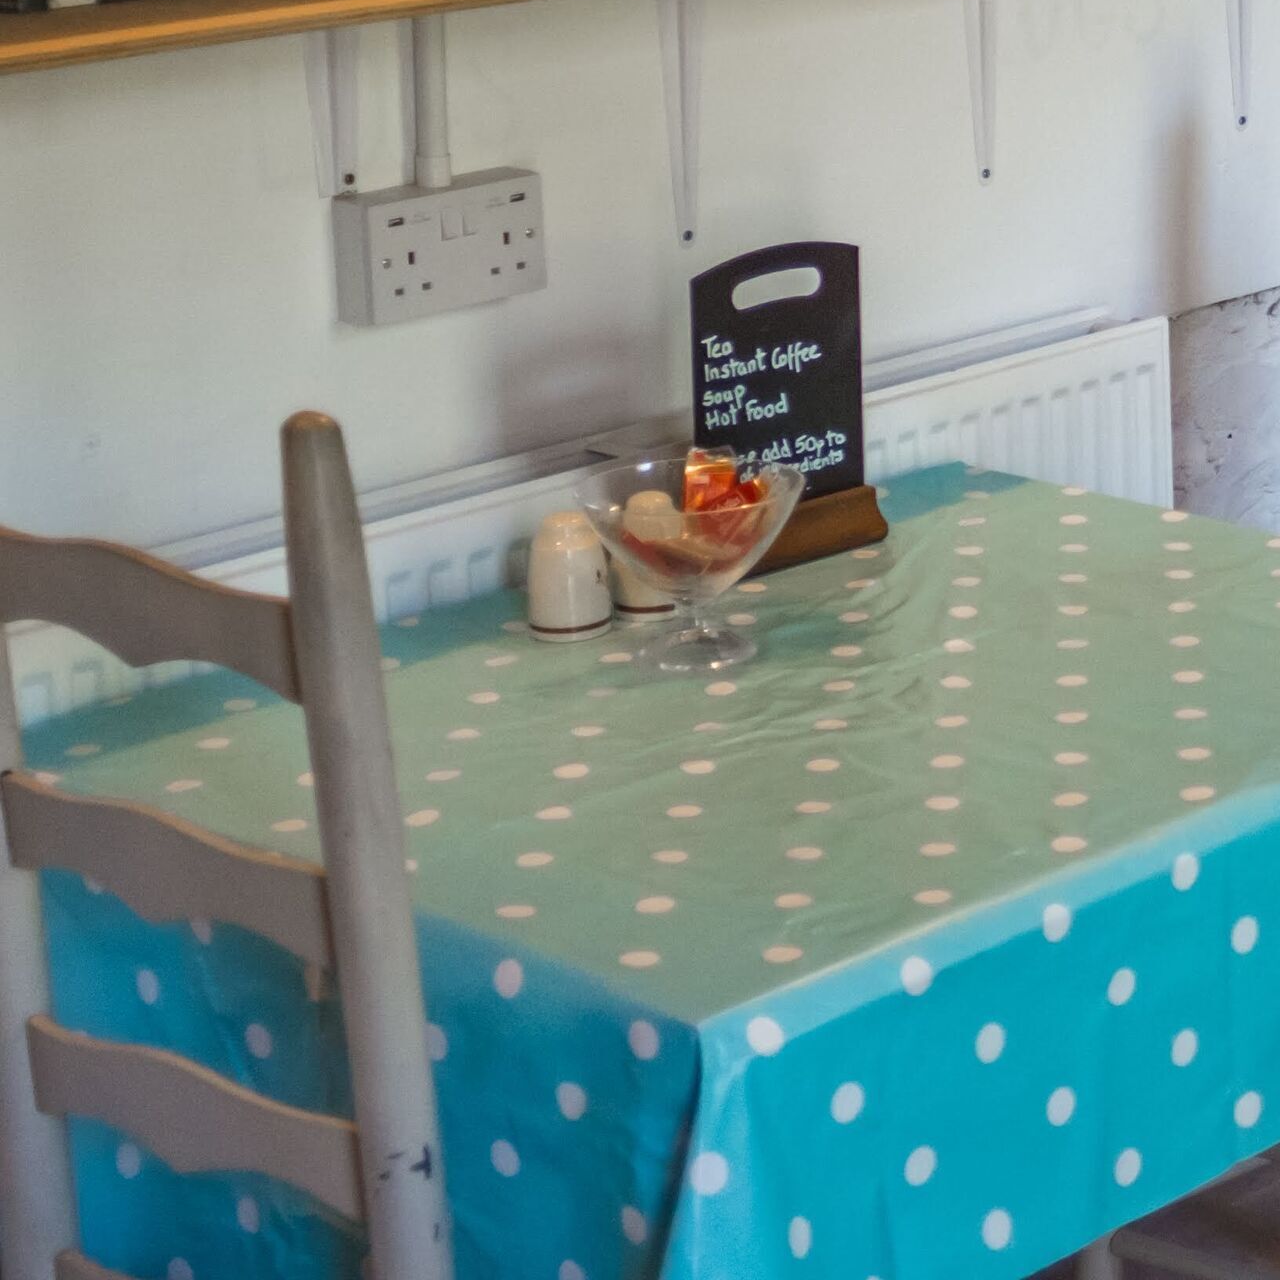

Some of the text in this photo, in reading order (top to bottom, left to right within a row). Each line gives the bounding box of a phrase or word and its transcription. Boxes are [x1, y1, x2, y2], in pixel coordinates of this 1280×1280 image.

[701, 334, 733, 358] Tea
[704, 342, 822, 382] Instant Coffee
[706, 392, 788, 430] Hot Food
[761, 438, 792, 462] add
[826, 430, 846, 445] to
